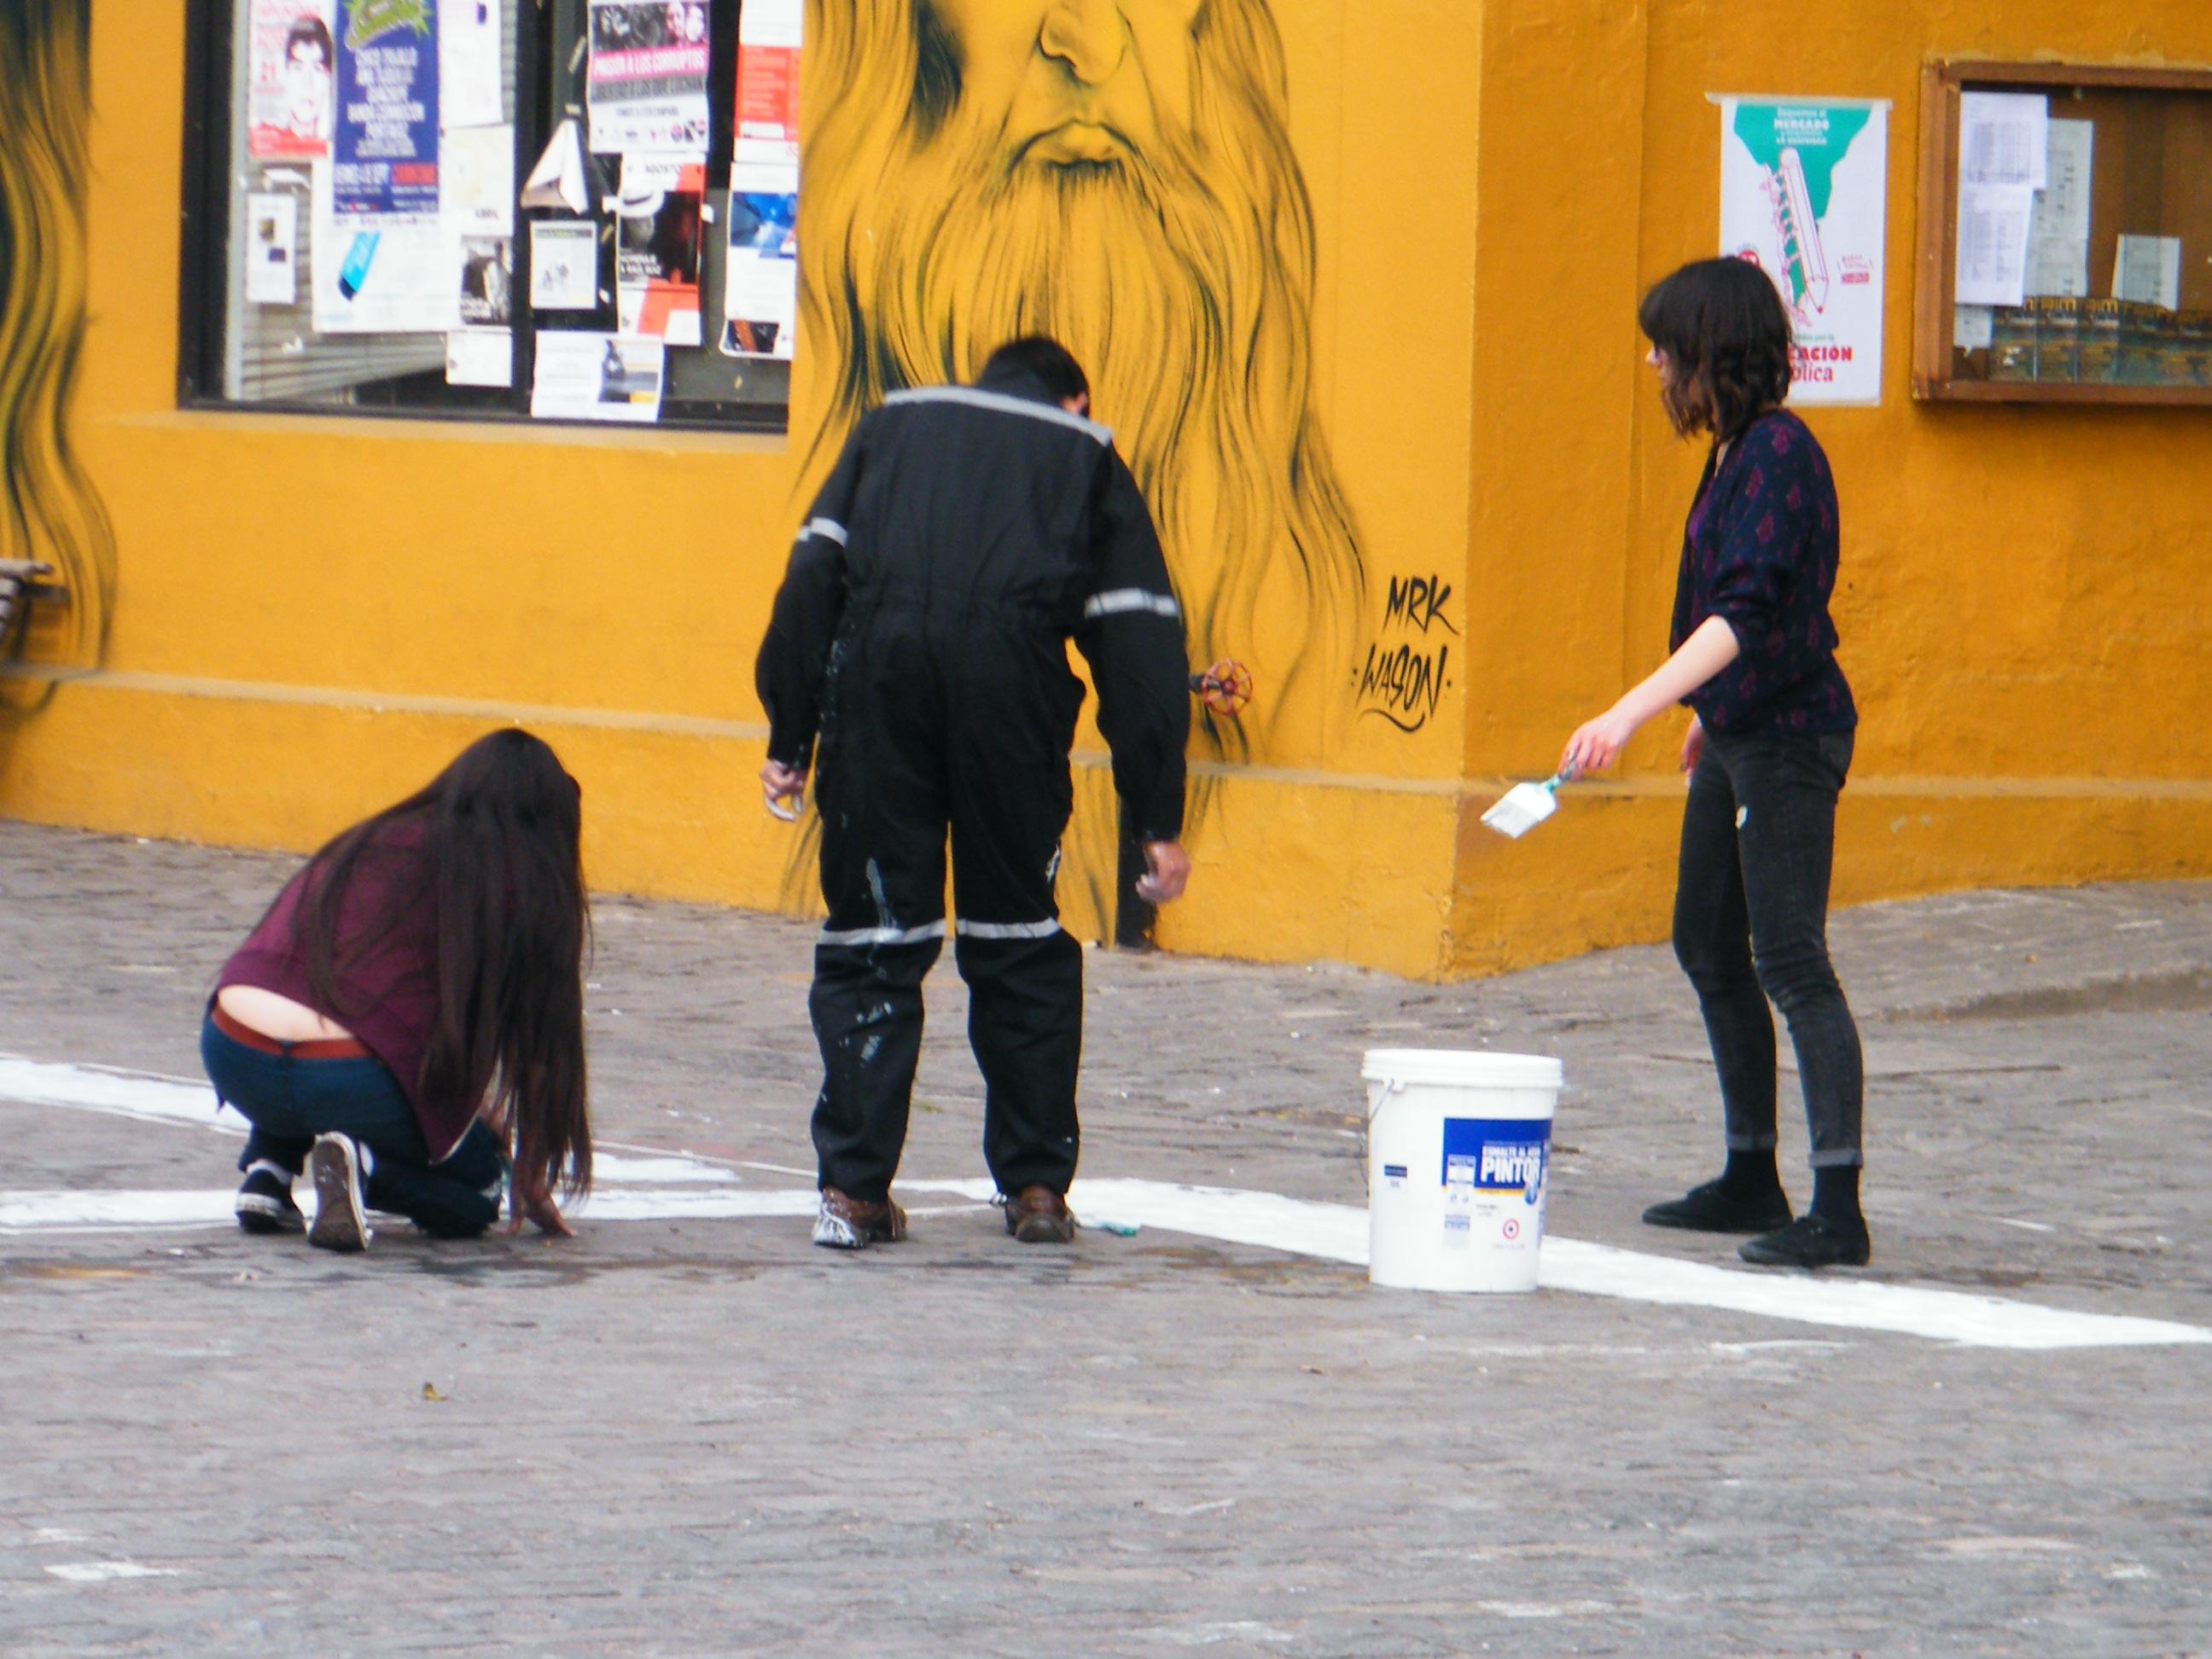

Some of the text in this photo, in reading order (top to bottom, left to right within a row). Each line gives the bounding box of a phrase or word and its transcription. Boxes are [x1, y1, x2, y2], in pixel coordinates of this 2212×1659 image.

[1773, 119, 1830, 131] MERCADO
[1383, 575, 1459, 635] MRK
[1481, 1156, 1540, 1183] PINTOR
